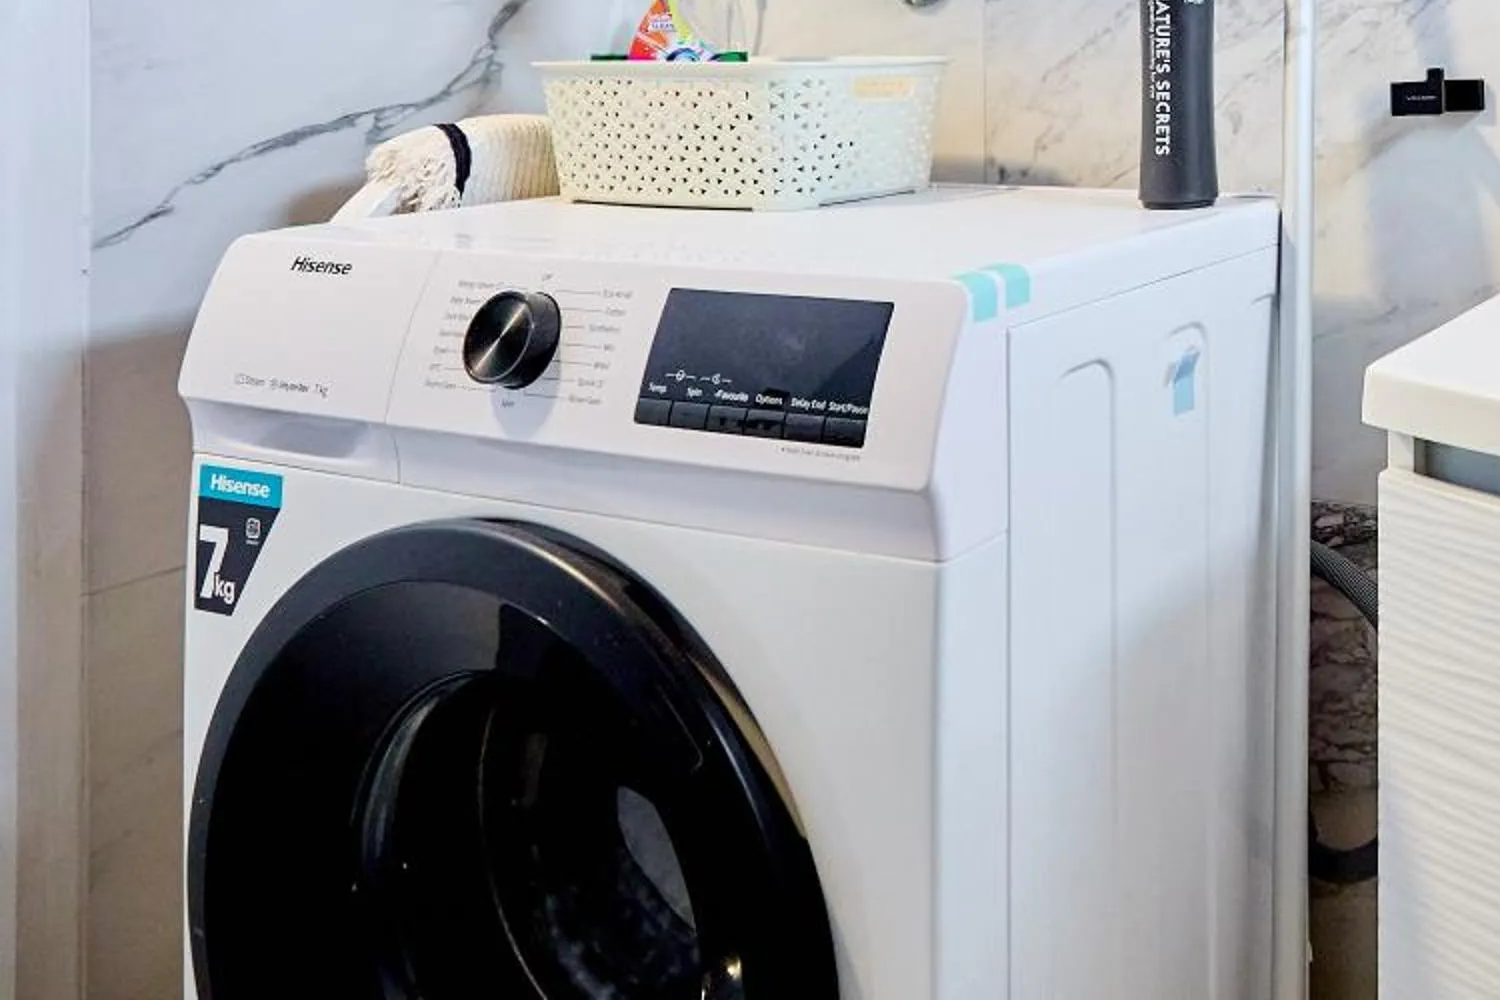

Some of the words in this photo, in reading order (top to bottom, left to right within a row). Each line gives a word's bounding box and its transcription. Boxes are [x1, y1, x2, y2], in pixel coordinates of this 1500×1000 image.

[1155, 81, 1171, 156] SECRETS
[291, 256, 352, 275] Hisense
[755, 393, 783, 405] Options
[210, 473, 270, 498] Hisense
